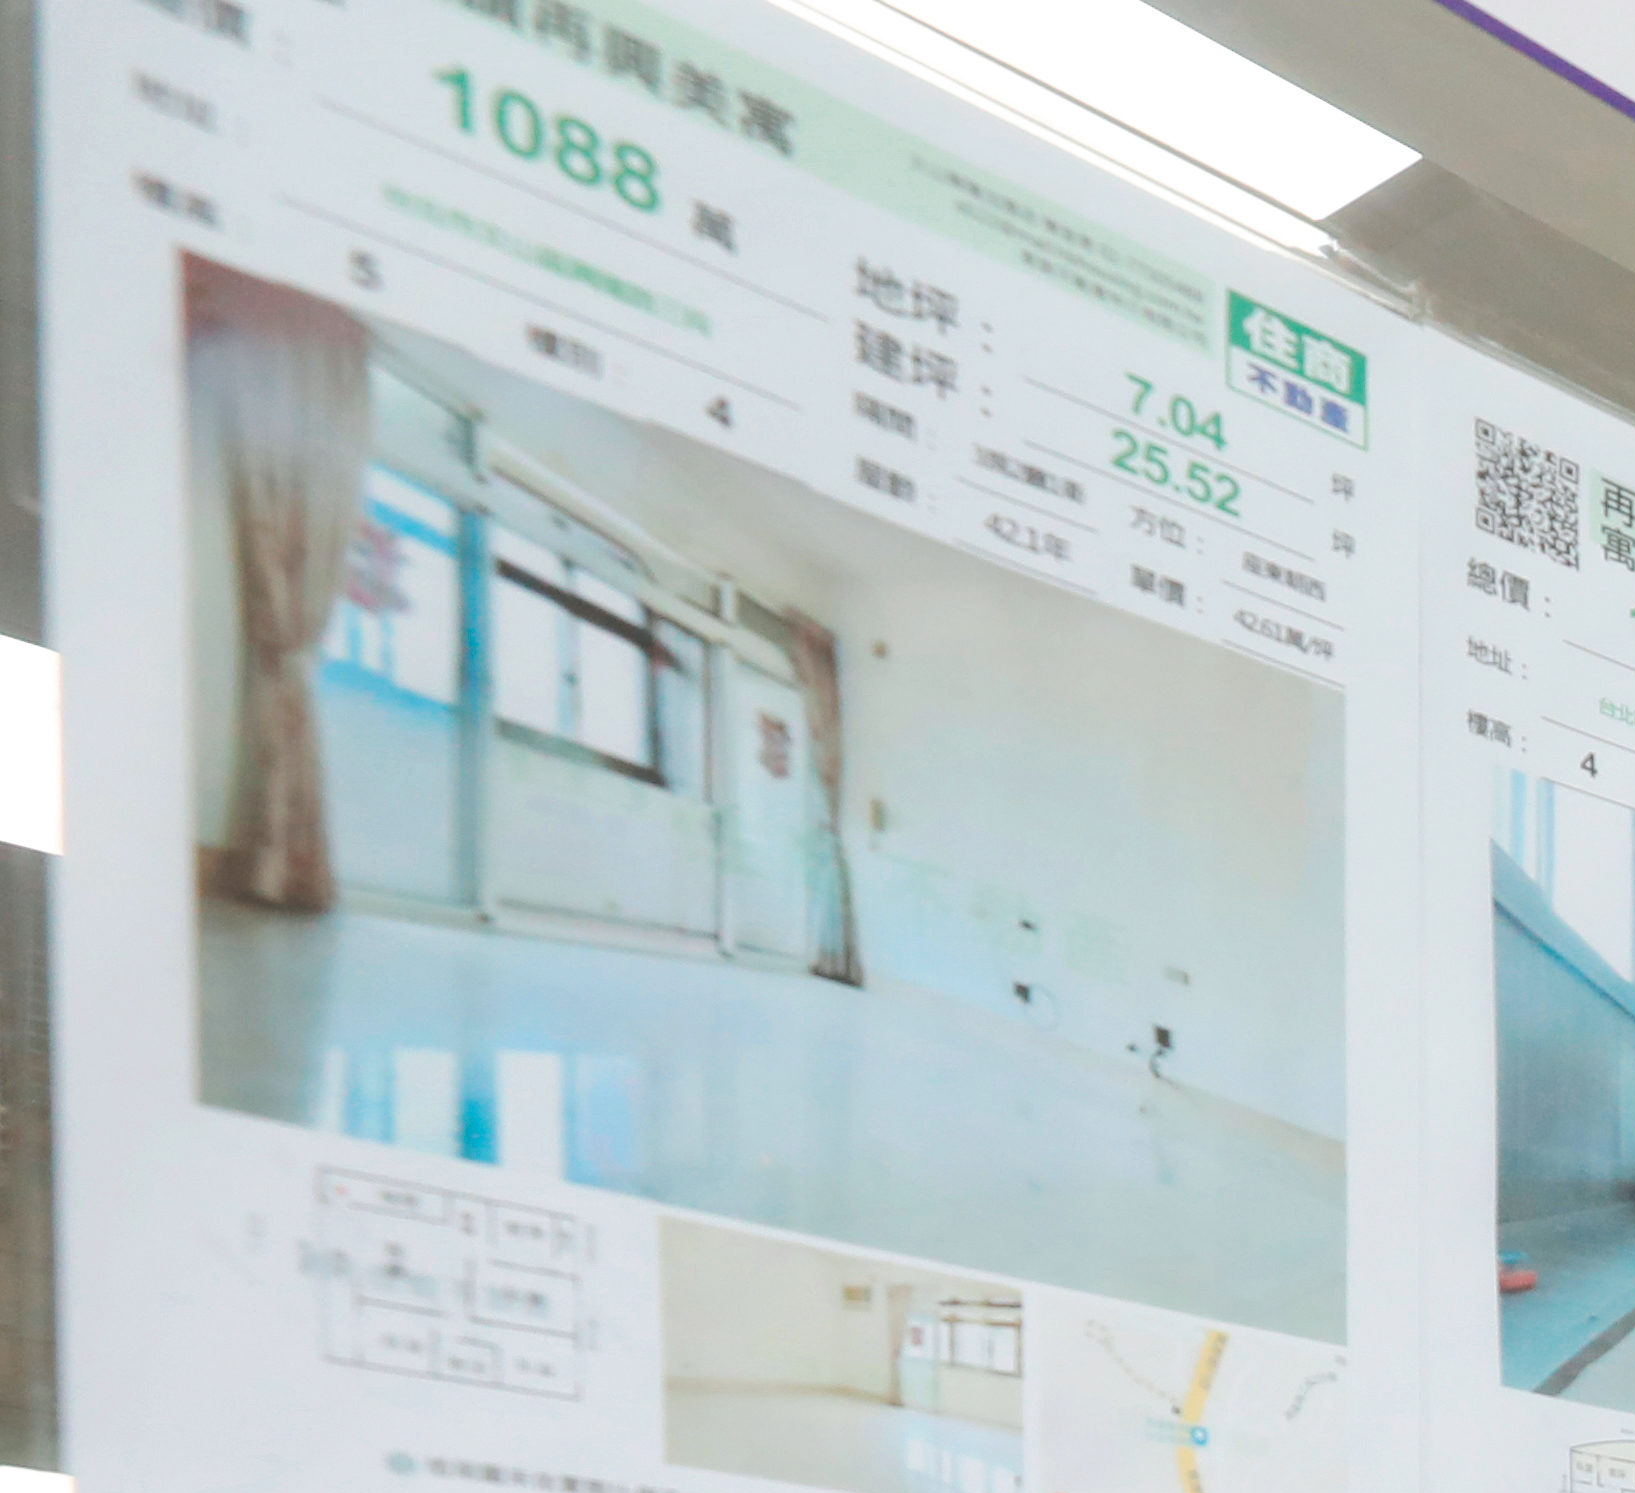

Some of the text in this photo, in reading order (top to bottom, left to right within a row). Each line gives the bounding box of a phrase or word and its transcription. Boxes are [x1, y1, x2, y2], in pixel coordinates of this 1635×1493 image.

[431, 64, 662, 214] 1088
[1241, 306, 1354, 396] 住商
[1125, 371, 1228, 453] 7.04
[1245, 362, 1350, 435] 不動產
[1110, 428, 1243, 519] 25.52
[1601, 525, 1635, 573] 寓
[1580, 752, 1598, 778] 4
